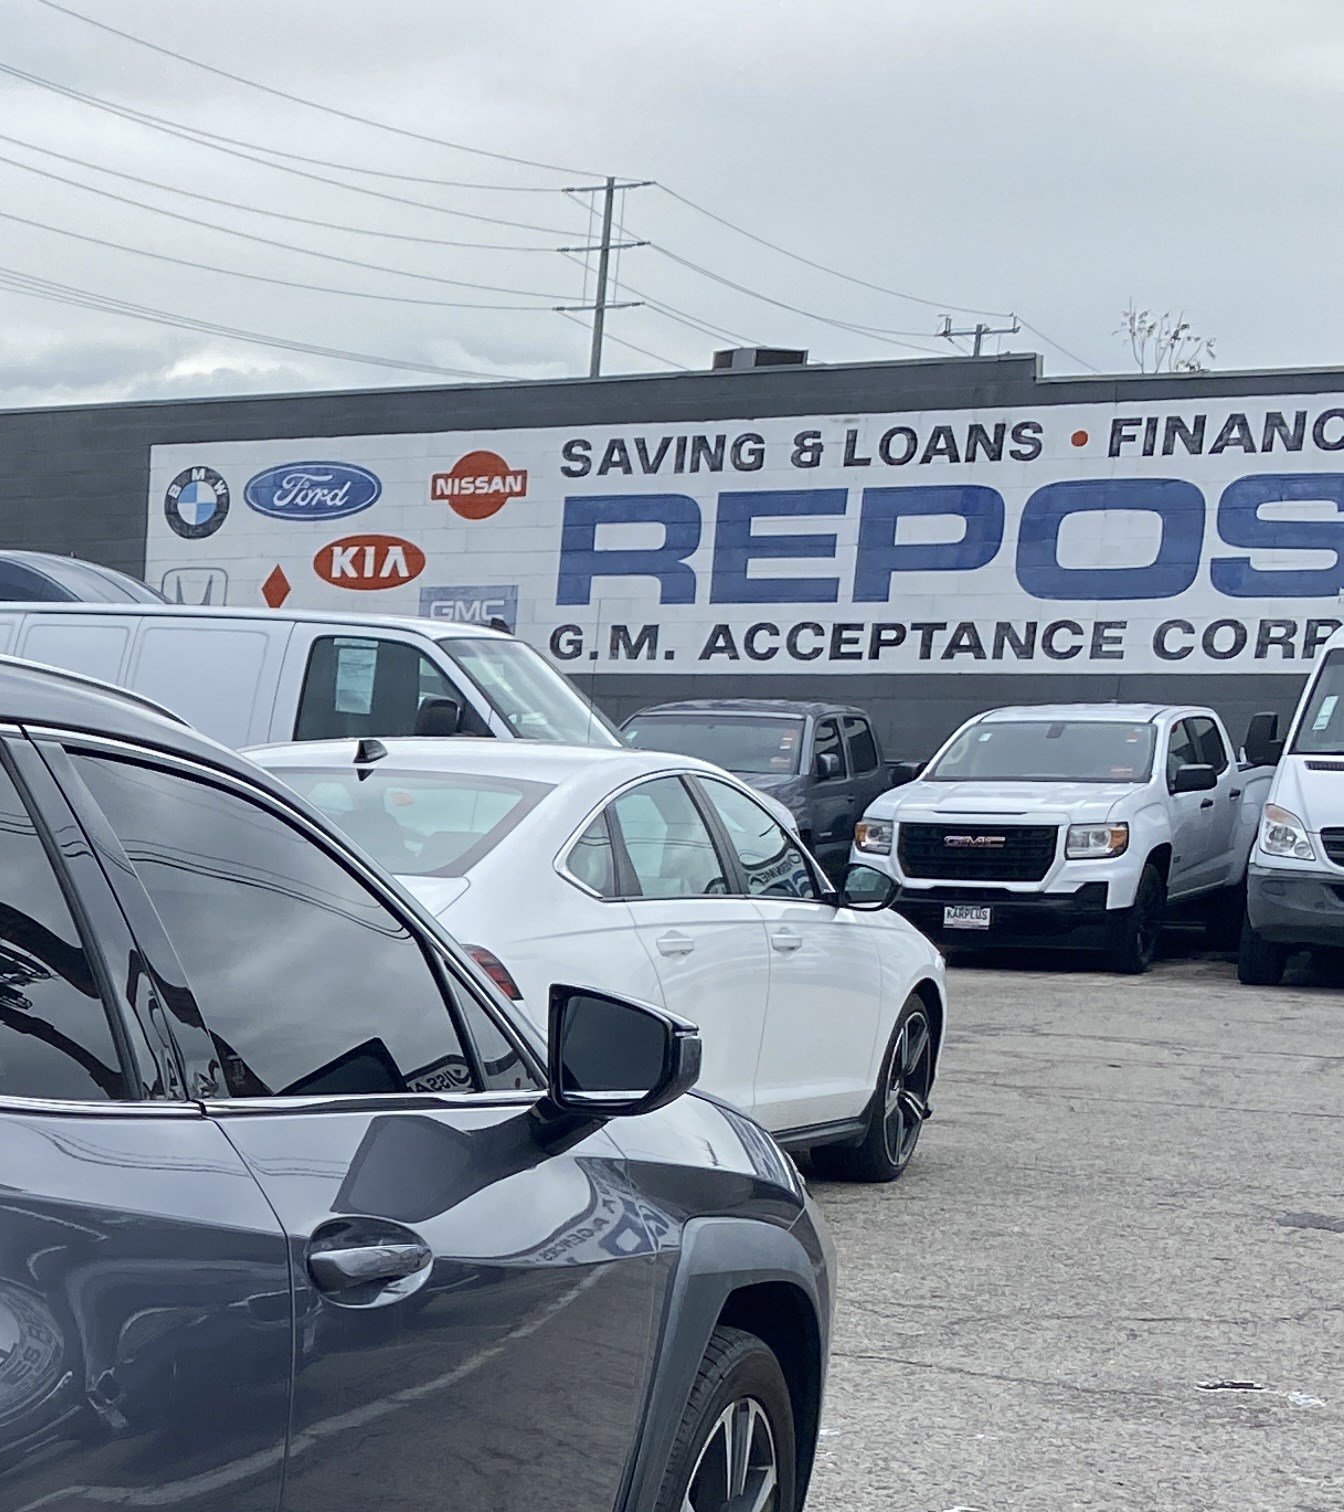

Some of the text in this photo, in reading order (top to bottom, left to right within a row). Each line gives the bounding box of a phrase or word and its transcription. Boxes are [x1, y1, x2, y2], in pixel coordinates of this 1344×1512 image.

[560, 409, 1344, 478] SAVING & LOANS FINANC
[273, 473, 351, 508] Ford
[435, 475, 523, 497] NISSAN
[556, 472, 1344, 605] REPOS
[331, 546, 411, 580] KIA
[430, 599, 506, 625] GMC
[549, 618, 1343, 662] G.M. ACCEPTANCE CORP
[943, 835, 1006, 848] GMC
